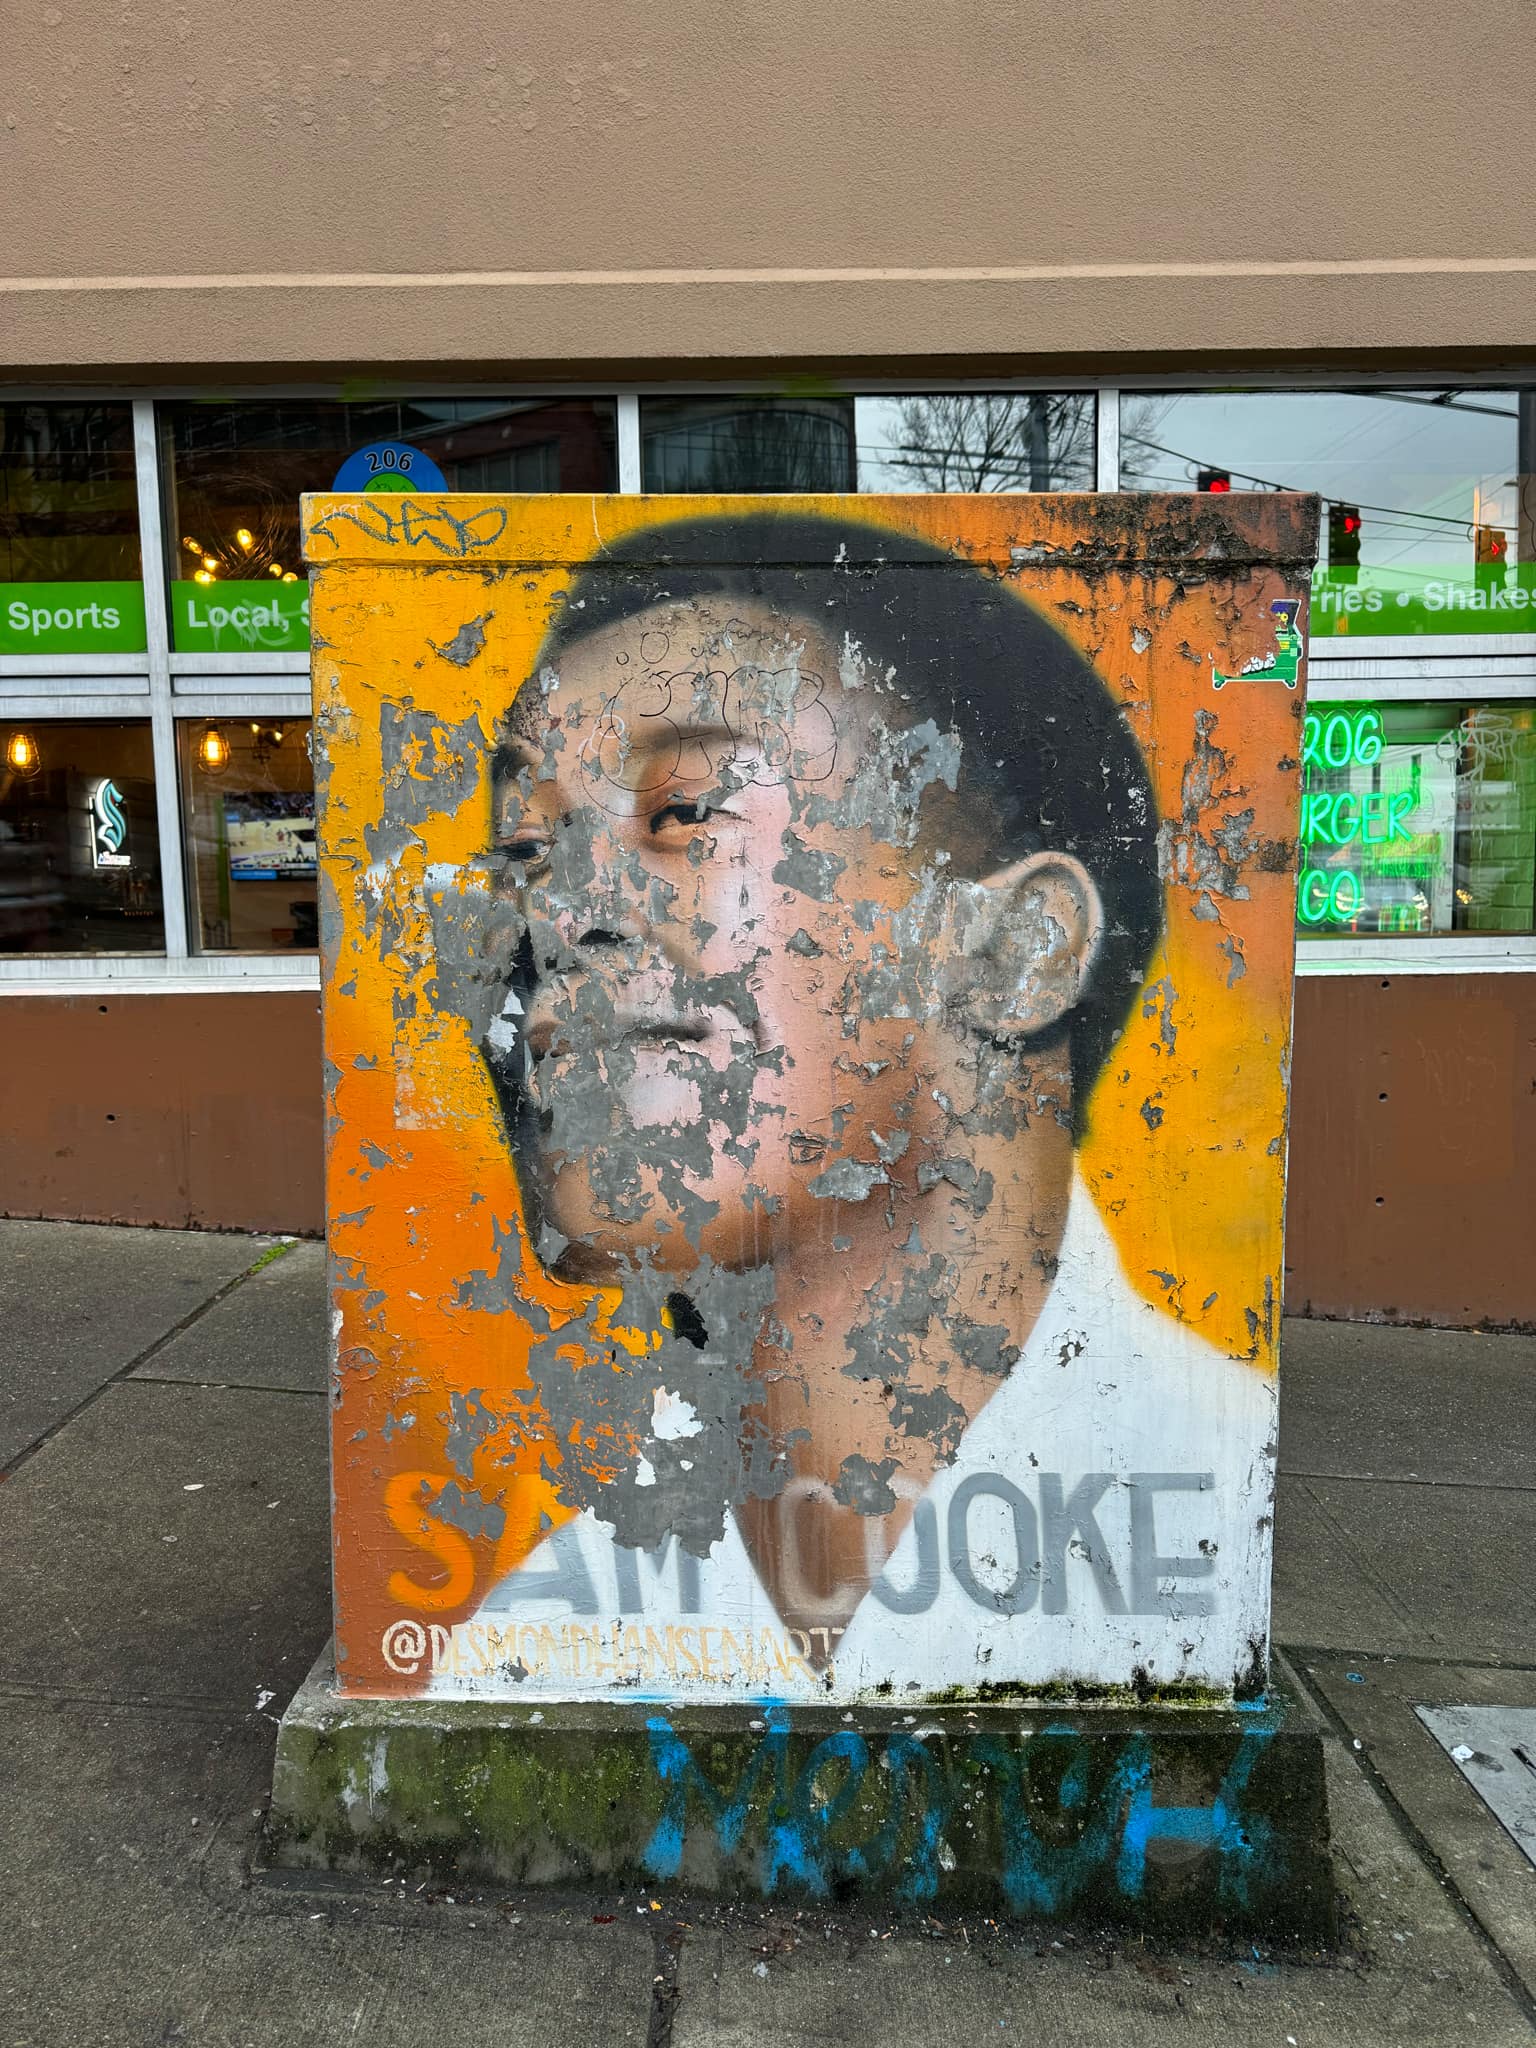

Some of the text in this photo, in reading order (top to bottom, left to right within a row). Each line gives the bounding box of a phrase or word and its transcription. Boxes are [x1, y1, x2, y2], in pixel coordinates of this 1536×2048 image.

[365, 450, 414, 472] 206
[8, 602, 120, 635] Sports
[188, 600, 289, 632] Local,
[1304, 715, 1382, 767] 206
